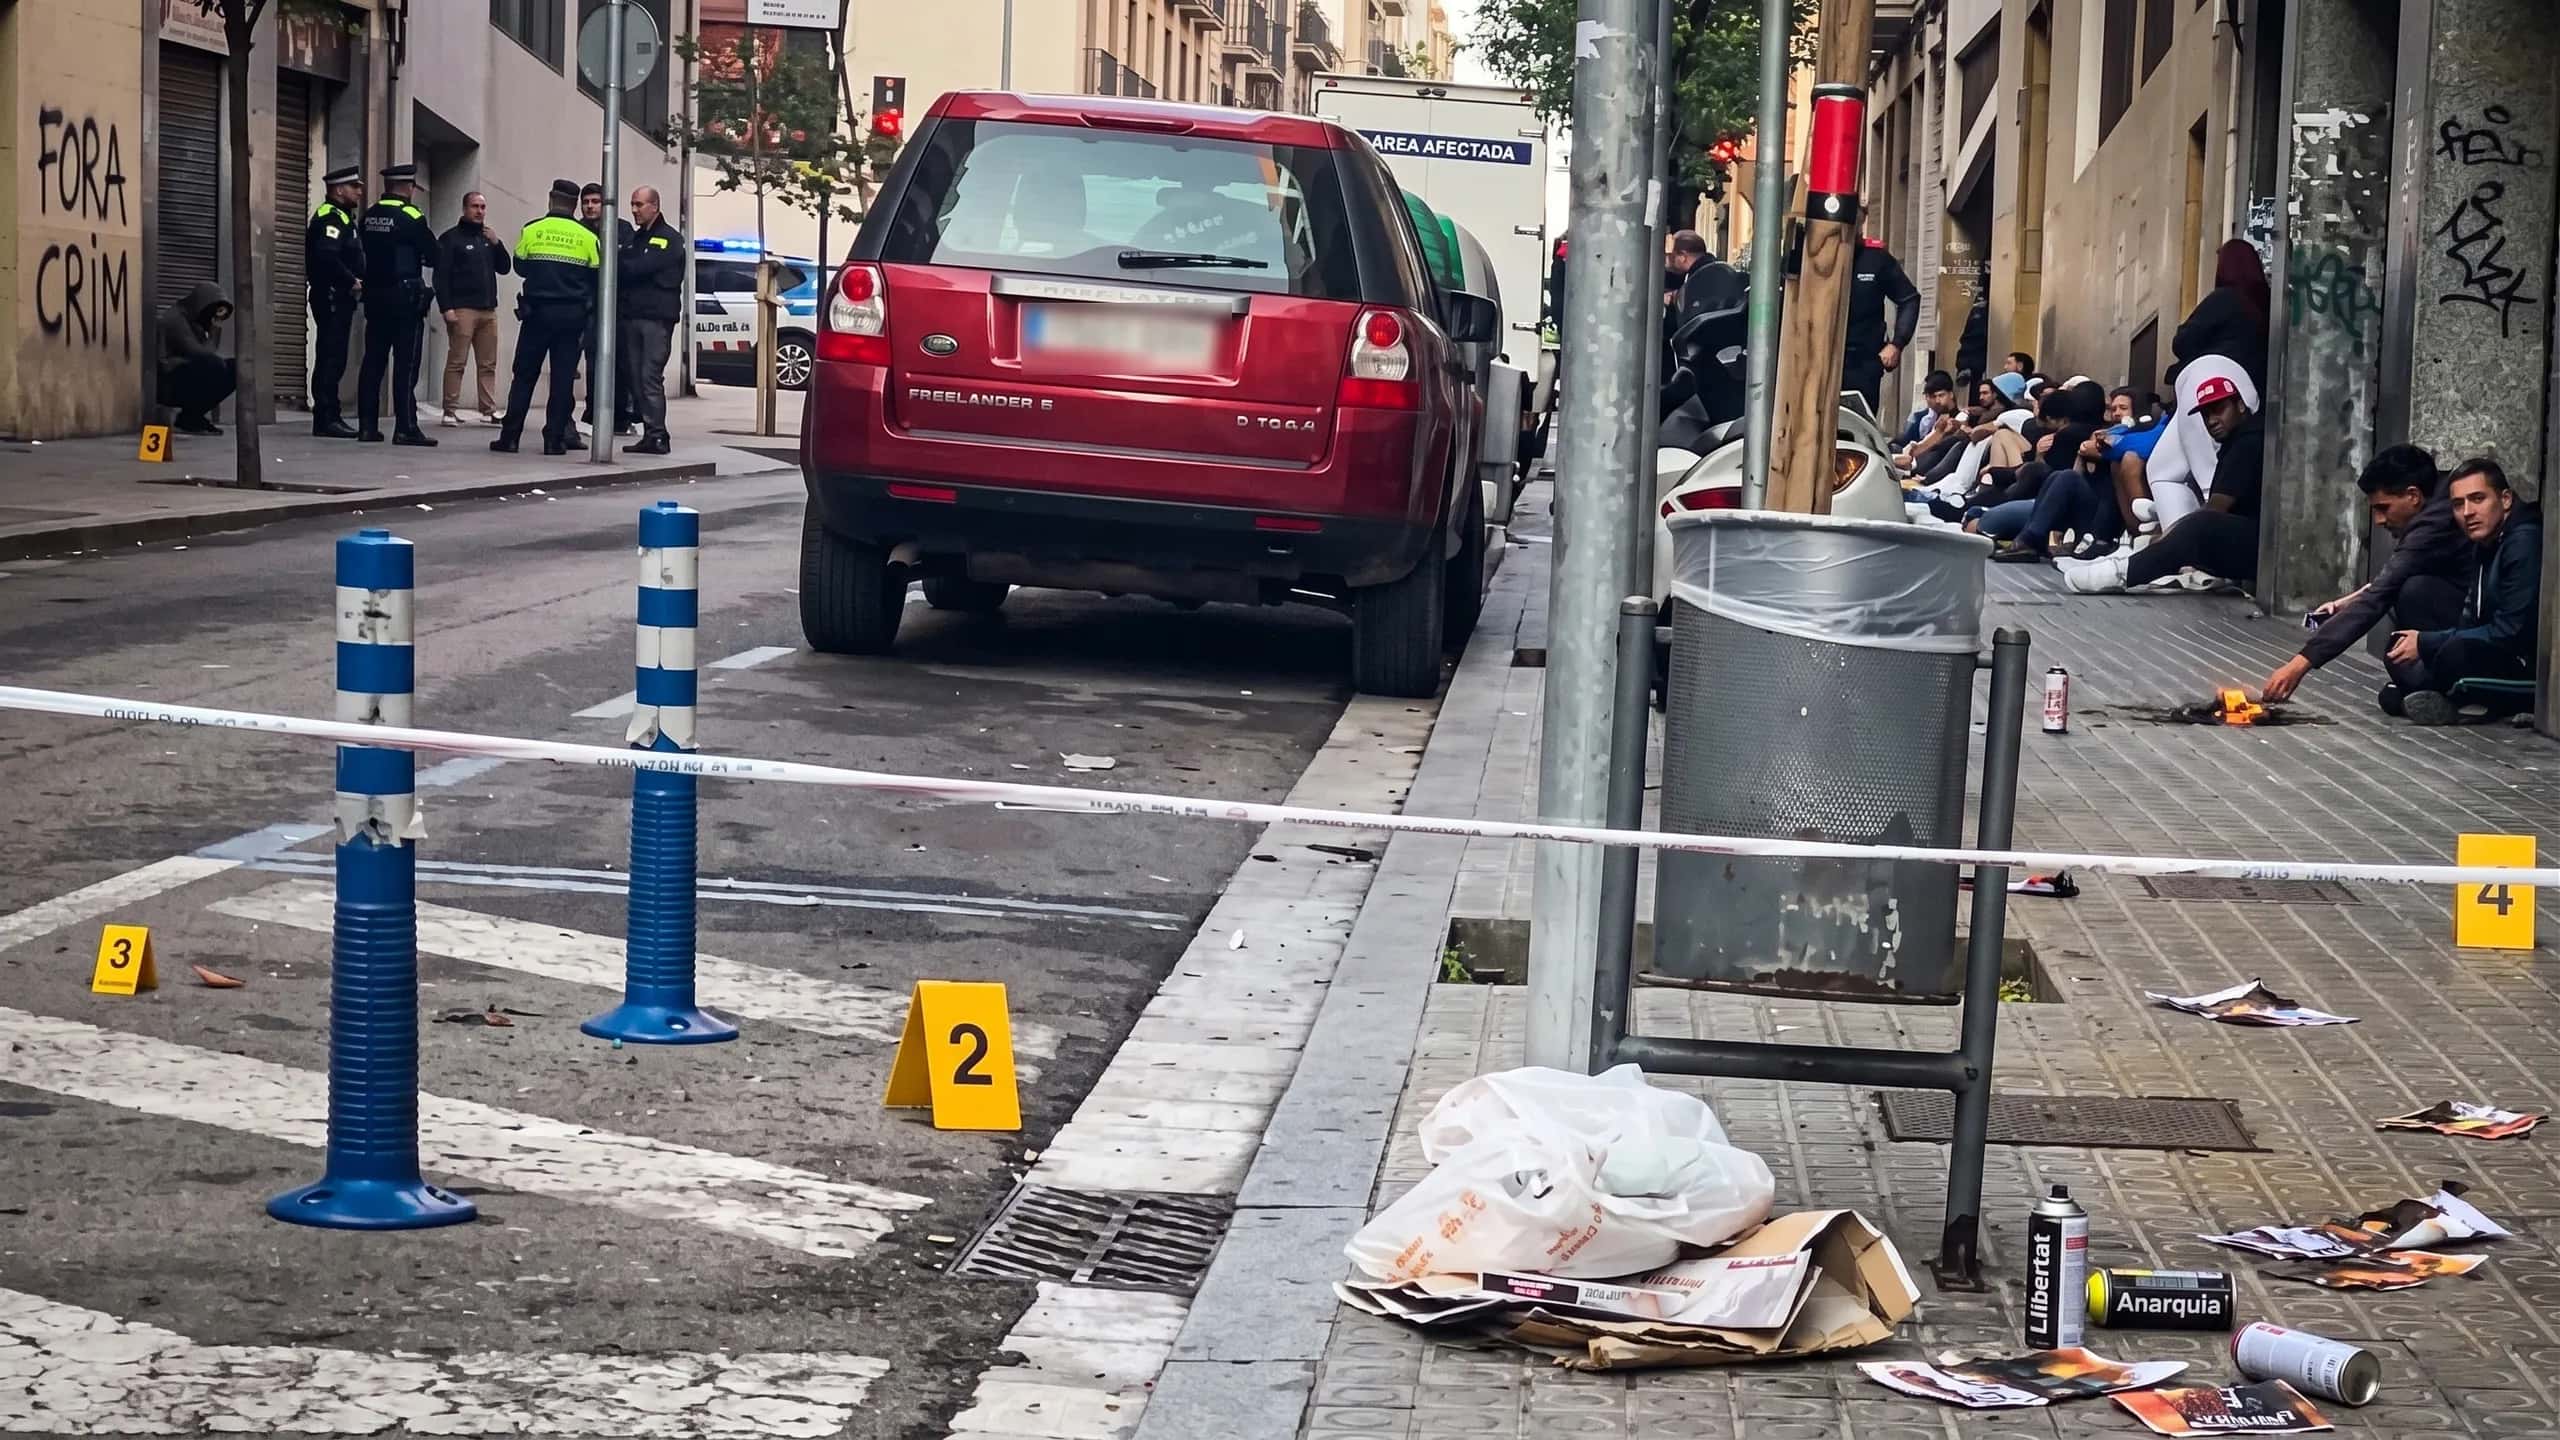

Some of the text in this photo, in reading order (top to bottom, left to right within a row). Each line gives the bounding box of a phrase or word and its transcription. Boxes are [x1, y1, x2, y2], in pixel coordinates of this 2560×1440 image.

[1372, 134, 1515, 161] AREA AFECTADA
[38, 103, 127, 227] FORA
[908, 388, 1033, 409] FREELANDER
[146, 432, 161, 454] 3
[2477, 866, 2514, 916] 4
[110, 938, 132, 969] 3
[949, 1023, 993, 1085] 2
[2030, 1233, 2051, 1335] Llibertat
[2116, 1291, 2221, 1319] Anarquia
